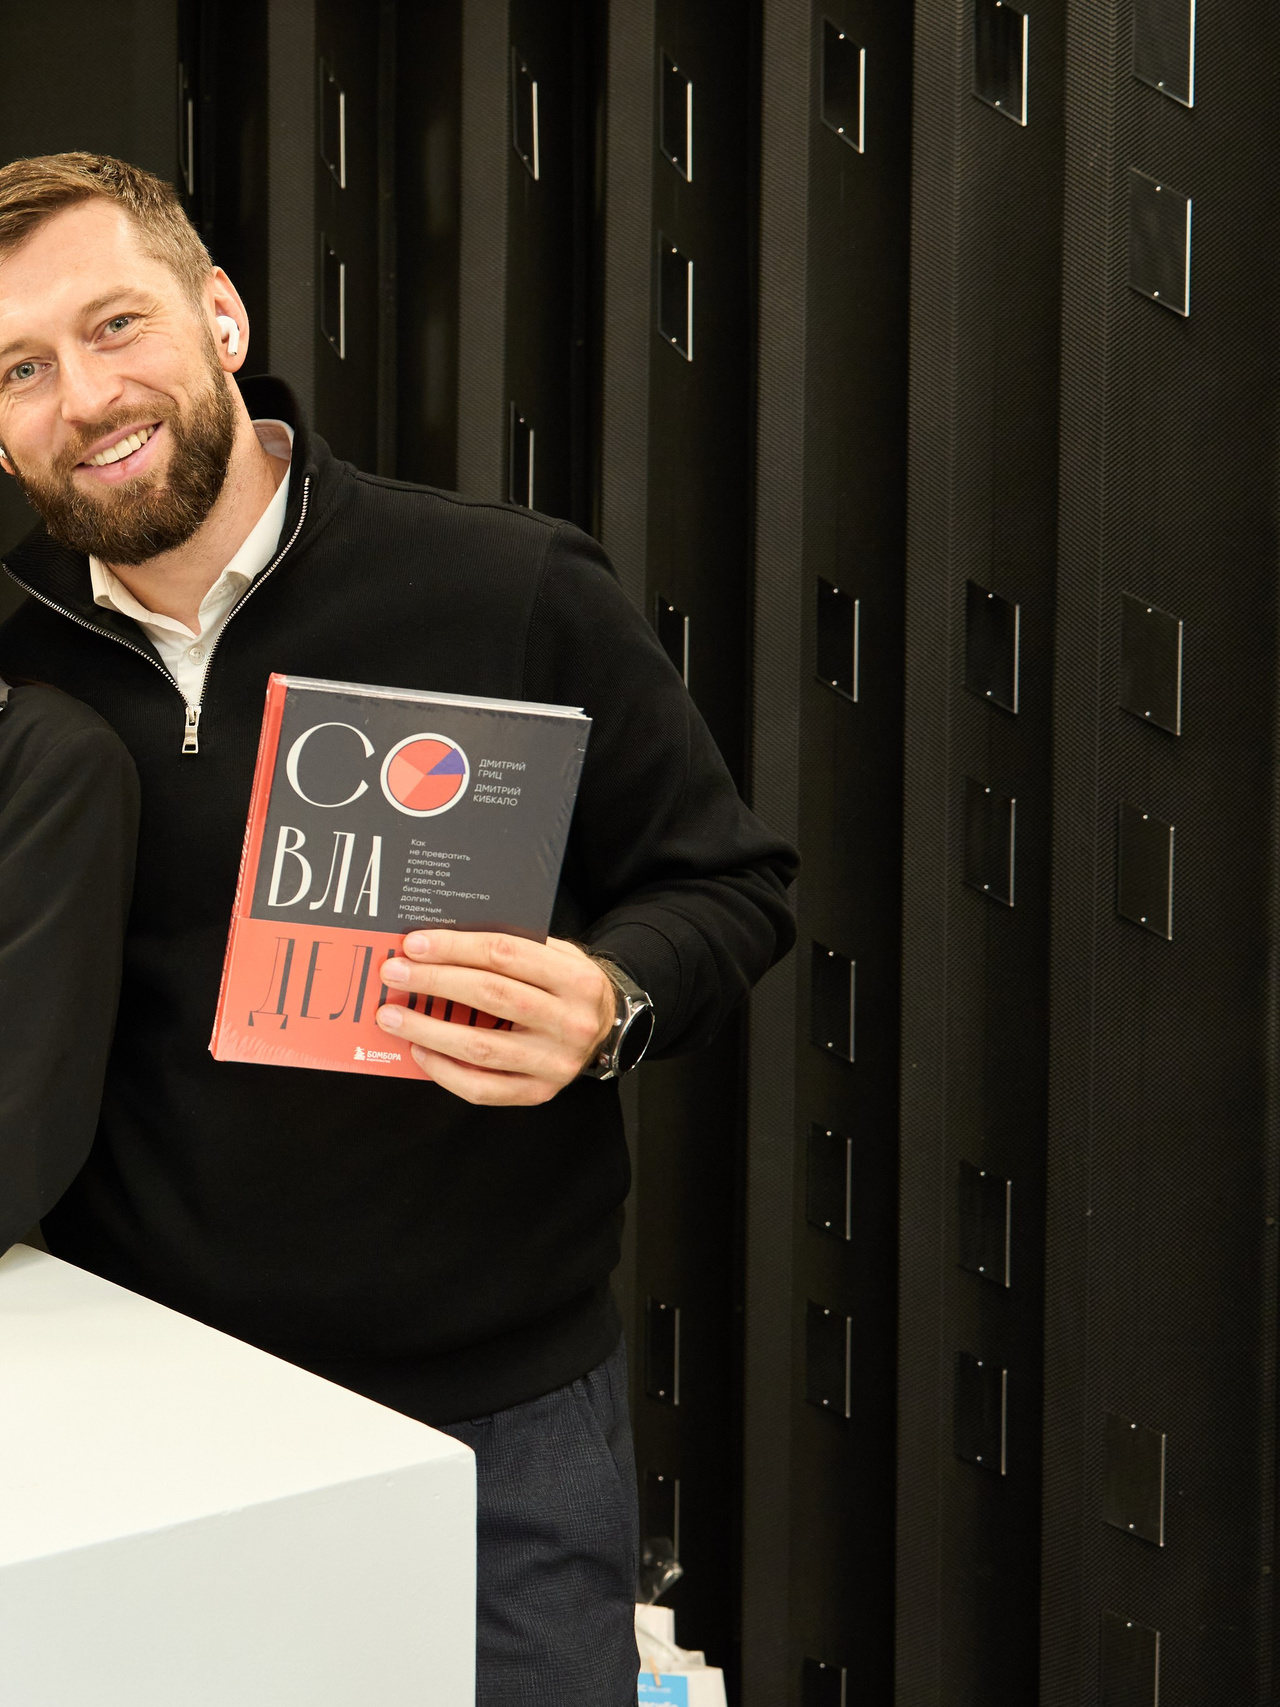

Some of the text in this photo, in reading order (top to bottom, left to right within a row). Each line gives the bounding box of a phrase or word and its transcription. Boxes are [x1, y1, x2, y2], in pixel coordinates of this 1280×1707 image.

[479, 759, 526, 771] ДМИТРИЙ
[477, 769, 503, 780] ГРИЦ
[474, 783, 521, 795] ДМИТРИЙ
[472, 794, 518, 806] КИБКАЛО
[411, 838, 426, 847] Как
[422, 850, 471, 861] превратить
[407, 858, 450, 868] компанию
[267, 825, 382, 917] ВЛА
[413, 868, 434, 876] поле
[435, 869, 451, 877] боя
[411, 877, 445, 887] сделать
[402, 885, 490, 900] бизнес-партнерство
[400, 895, 432, 904] долгим,
[399, 904, 442, 914] надежным
[405, 913, 457, 924] прибыльным
[366, 1050, 402, 1061] БОМБОРА
